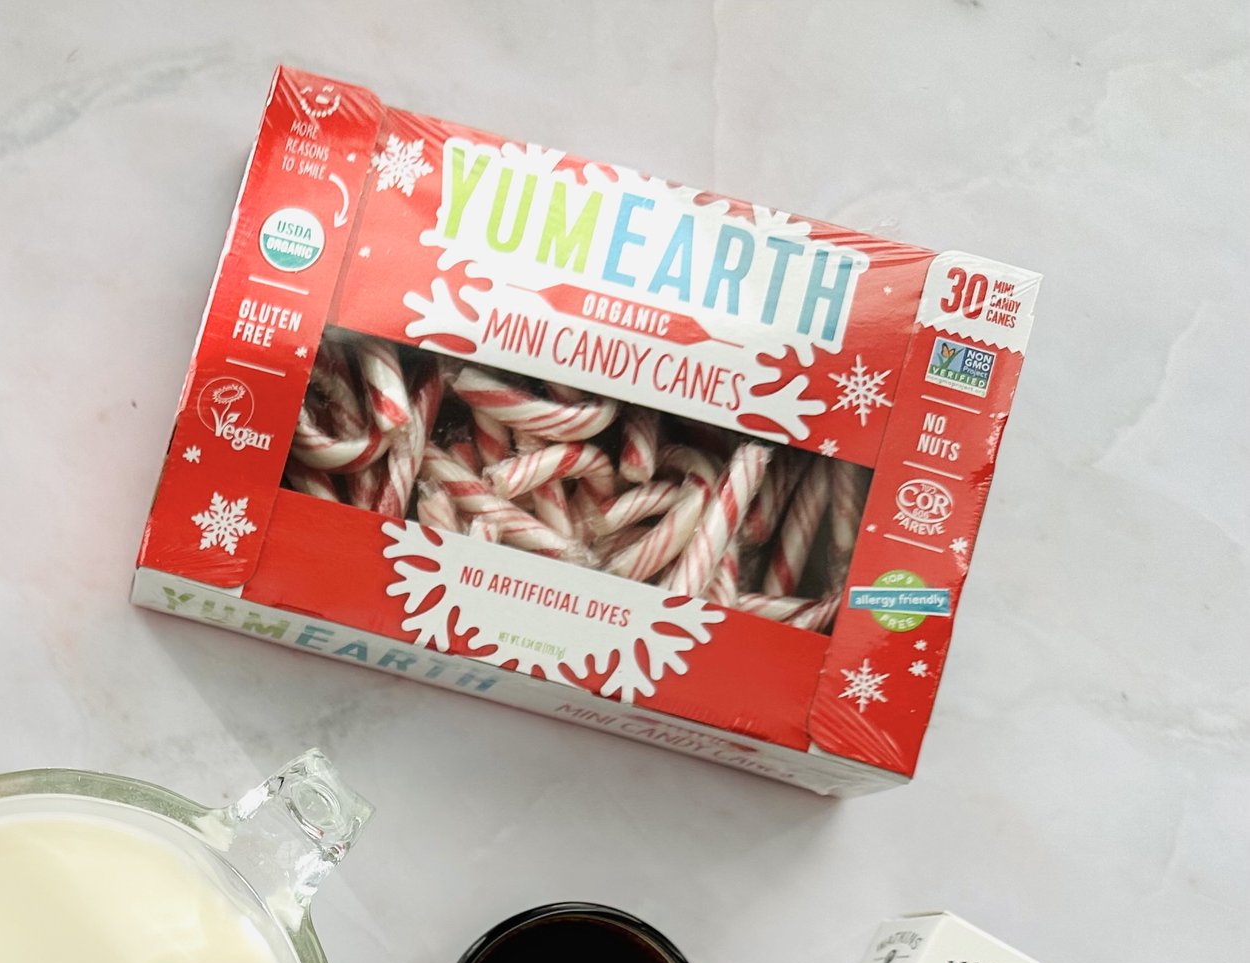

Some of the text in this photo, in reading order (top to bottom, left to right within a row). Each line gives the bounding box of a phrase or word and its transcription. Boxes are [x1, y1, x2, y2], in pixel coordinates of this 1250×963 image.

[290, 120, 319, 140] MORE
[285, 138, 329, 161] REASONS
[282, 156, 326, 180] TO SMILE
[277, 220, 312, 240] USDA
[266, 237, 314, 260] ORGANIC
[444, 147, 853, 341] YUMEARTH
[940, 267, 988, 319] 30
[993, 280, 1015, 296] MINI
[239, 299, 302, 332] GLUTEN
[582, 294, 671, 337] ORGANIC
[990, 295, 1021, 313] CANDY
[986, 310, 1016, 328] CANES
[232, 320, 276, 348] FREE
[482, 307, 745, 411] MINI CANDY CANES
[965, 358, 990, 371] GMO
[967, 350, 992, 363] NON
[932, 367, 985, 387] VERIFIED
[963, 366, 988, 378] Project
[211, 407, 271, 450] Vegan
[923, 412, 947, 435] NO
[916, 433, 960, 462] NUTS
[899, 486, 950, 517] COR
[893, 512, 946, 535] PAREVE
[459, 566, 632, 628] NO ARTIFICIAL DYES
[855, 594, 945, 608] allergy friendly
[555, 704, 615, 725] MINI
[621, 722, 707, 751] CANDY
